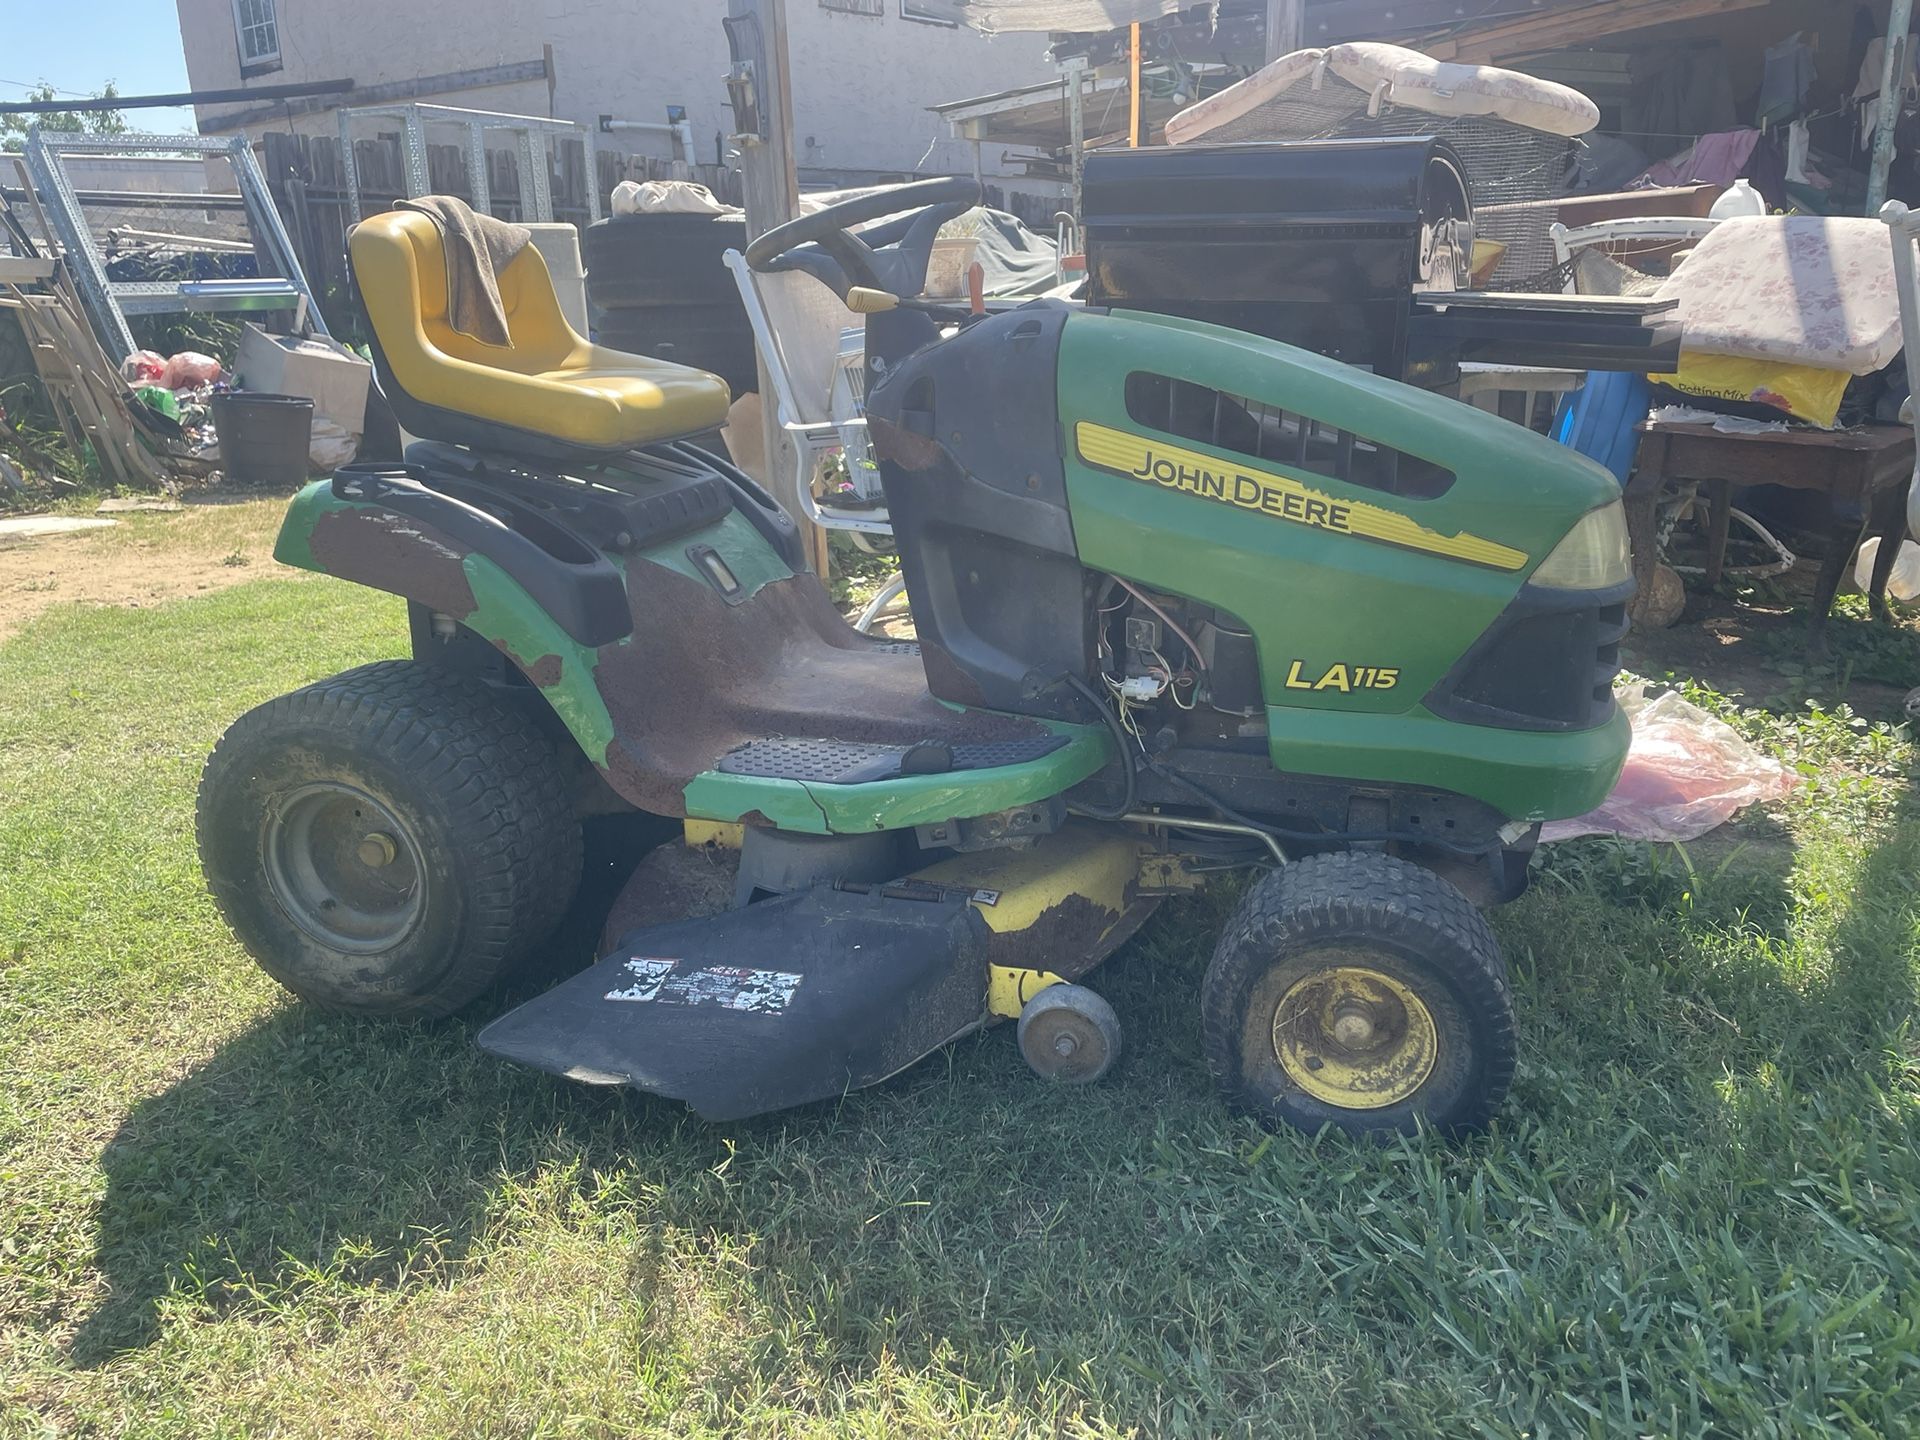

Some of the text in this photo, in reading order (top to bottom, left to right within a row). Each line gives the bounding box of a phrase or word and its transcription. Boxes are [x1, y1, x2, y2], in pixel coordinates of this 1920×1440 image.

[1723, 388, 1748, 401] Mix
[1132, 451, 1351, 530] JOHN DEERE
[1285, 660, 1400, 692] LA115
